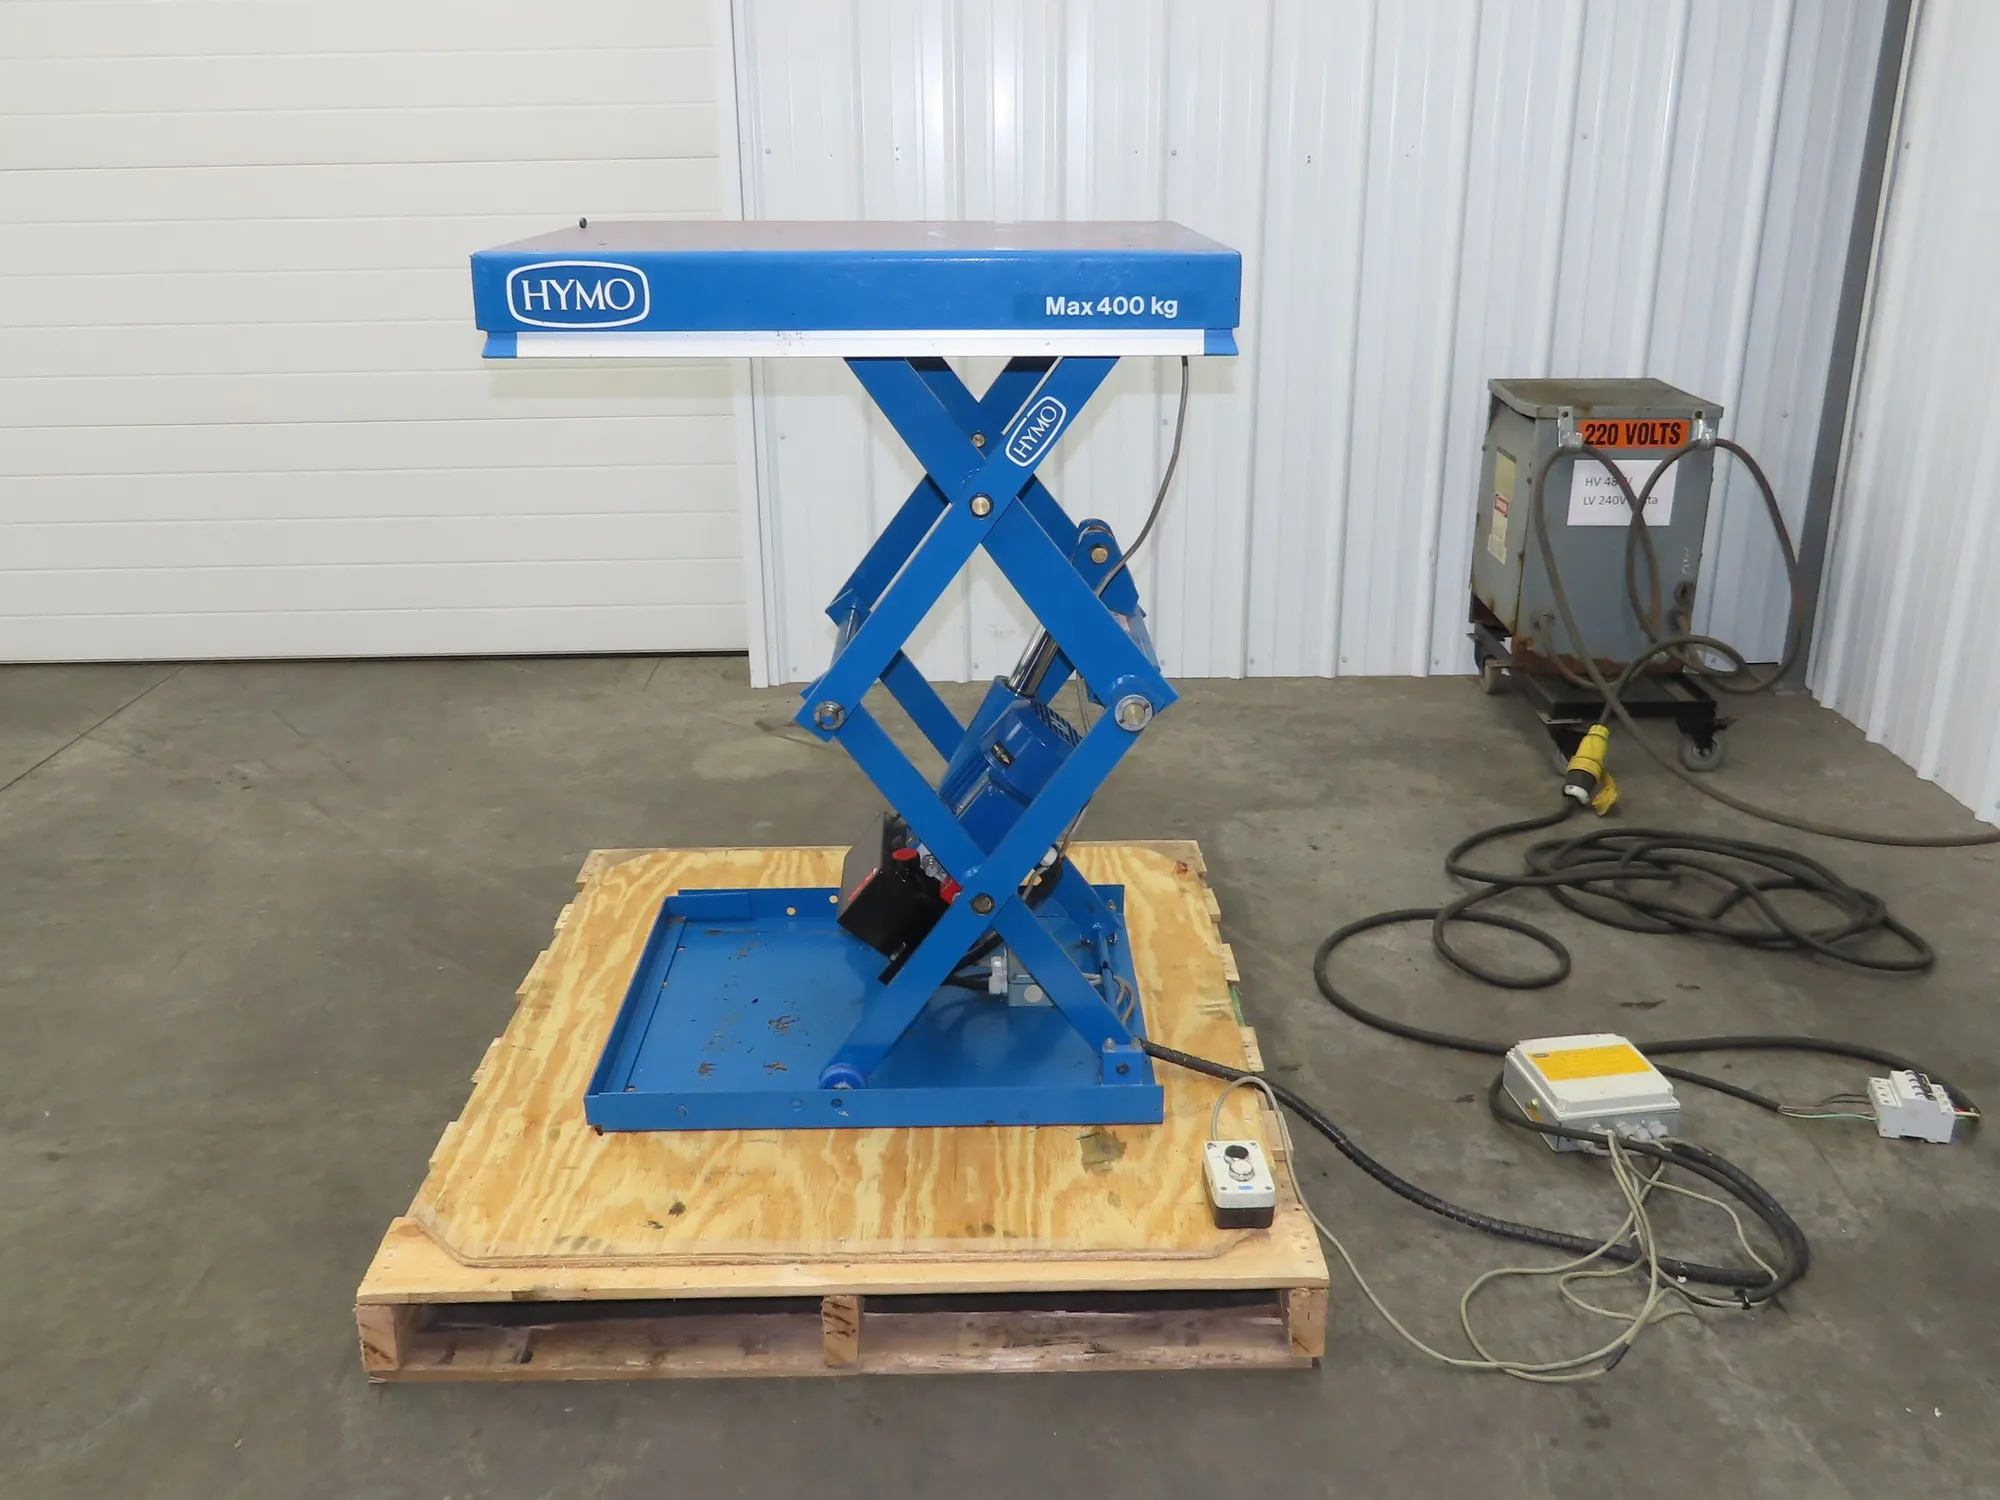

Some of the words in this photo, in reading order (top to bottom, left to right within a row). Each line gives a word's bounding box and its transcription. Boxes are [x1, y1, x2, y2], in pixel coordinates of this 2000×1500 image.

[521, 278, 635, 311] HYMO
[1045, 296, 1093, 316] Max
[1096, 296, 1145, 316] 400
[1151, 296, 1178, 319] kg
[1012, 405, 1057, 459] HYMO
[1584, 423, 1619, 446] 220
[1625, 422, 1681, 445] VOLTS
[1585, 477, 1602, 487] HV
[1603, 476, 1634, 487] 48V
[1583, 496, 1597, 506] LV
[1598, 495, 1627, 506] 240V
